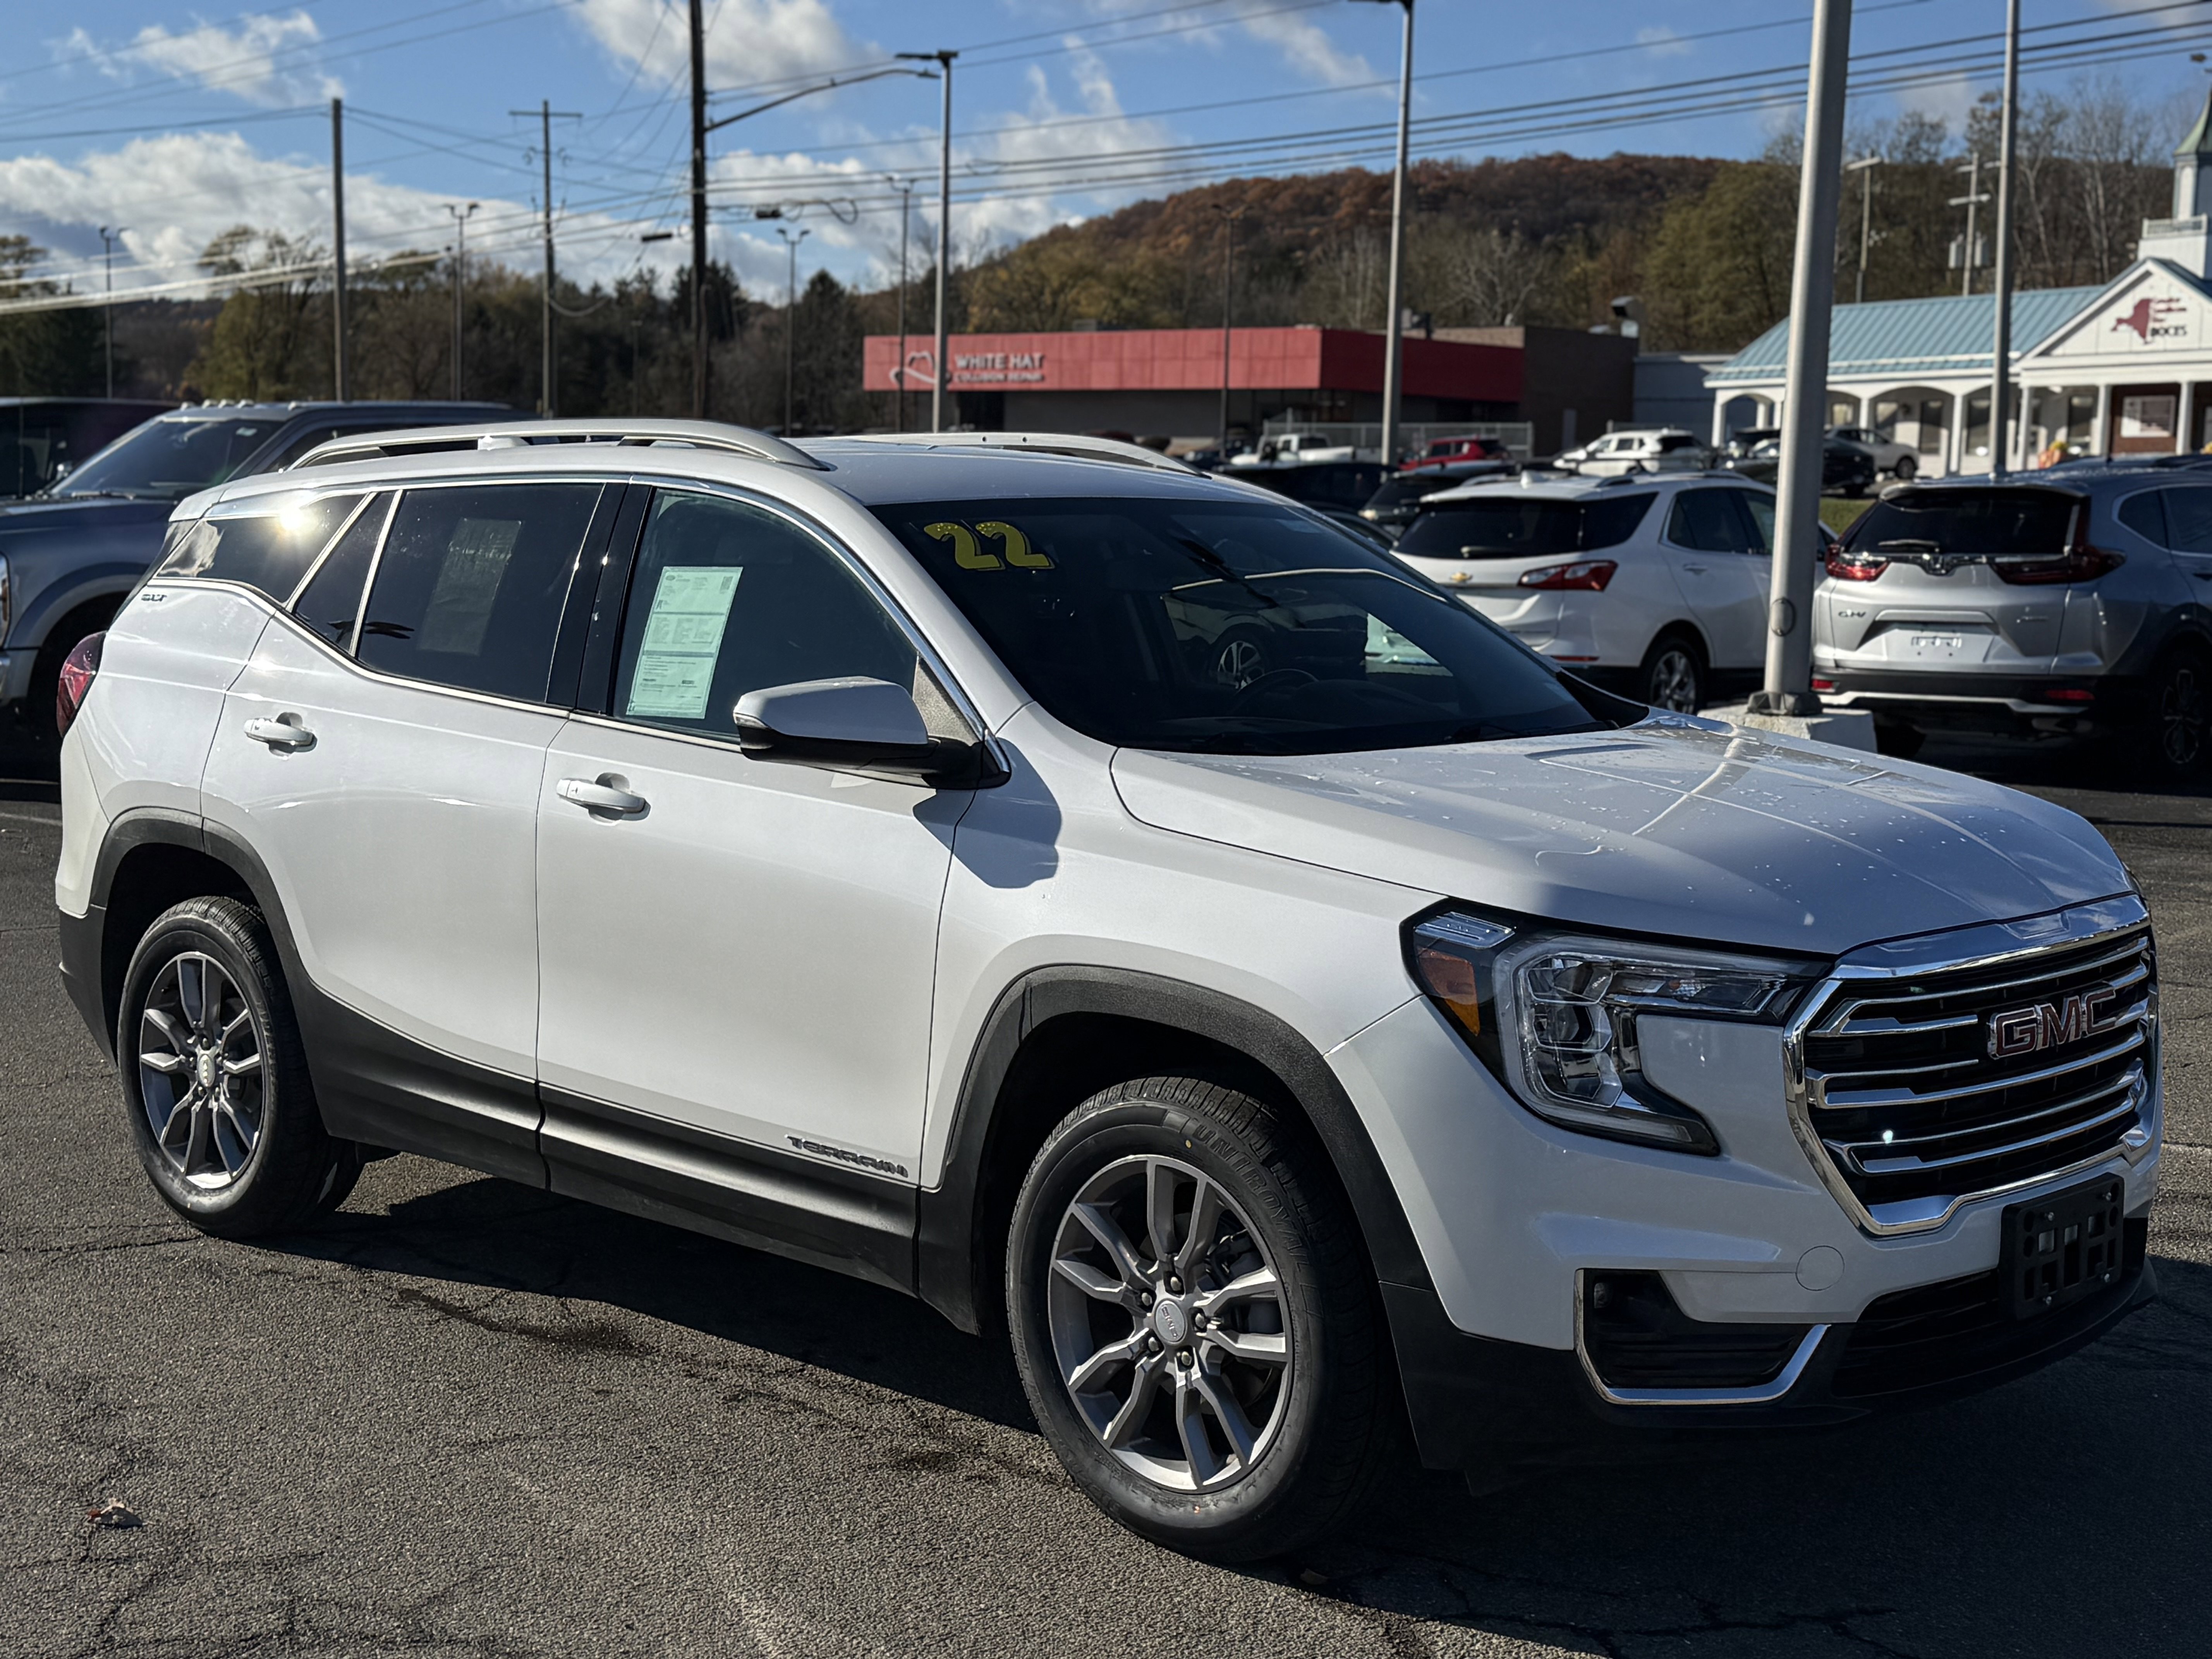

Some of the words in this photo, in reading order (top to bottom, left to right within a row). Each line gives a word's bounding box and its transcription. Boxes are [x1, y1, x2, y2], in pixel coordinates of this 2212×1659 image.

[954, 353, 1007, 369] WHITE
[1009, 352, 1044, 369] HAT
[924, 521, 1055, 571] 22
[141, 594, 167, 602] SLT
[1987, 986, 2116, 1060] GMC
[784, 1134, 909, 1178] TERRAIN
[1193, 1123, 1310, 1273] UNIROYAL
